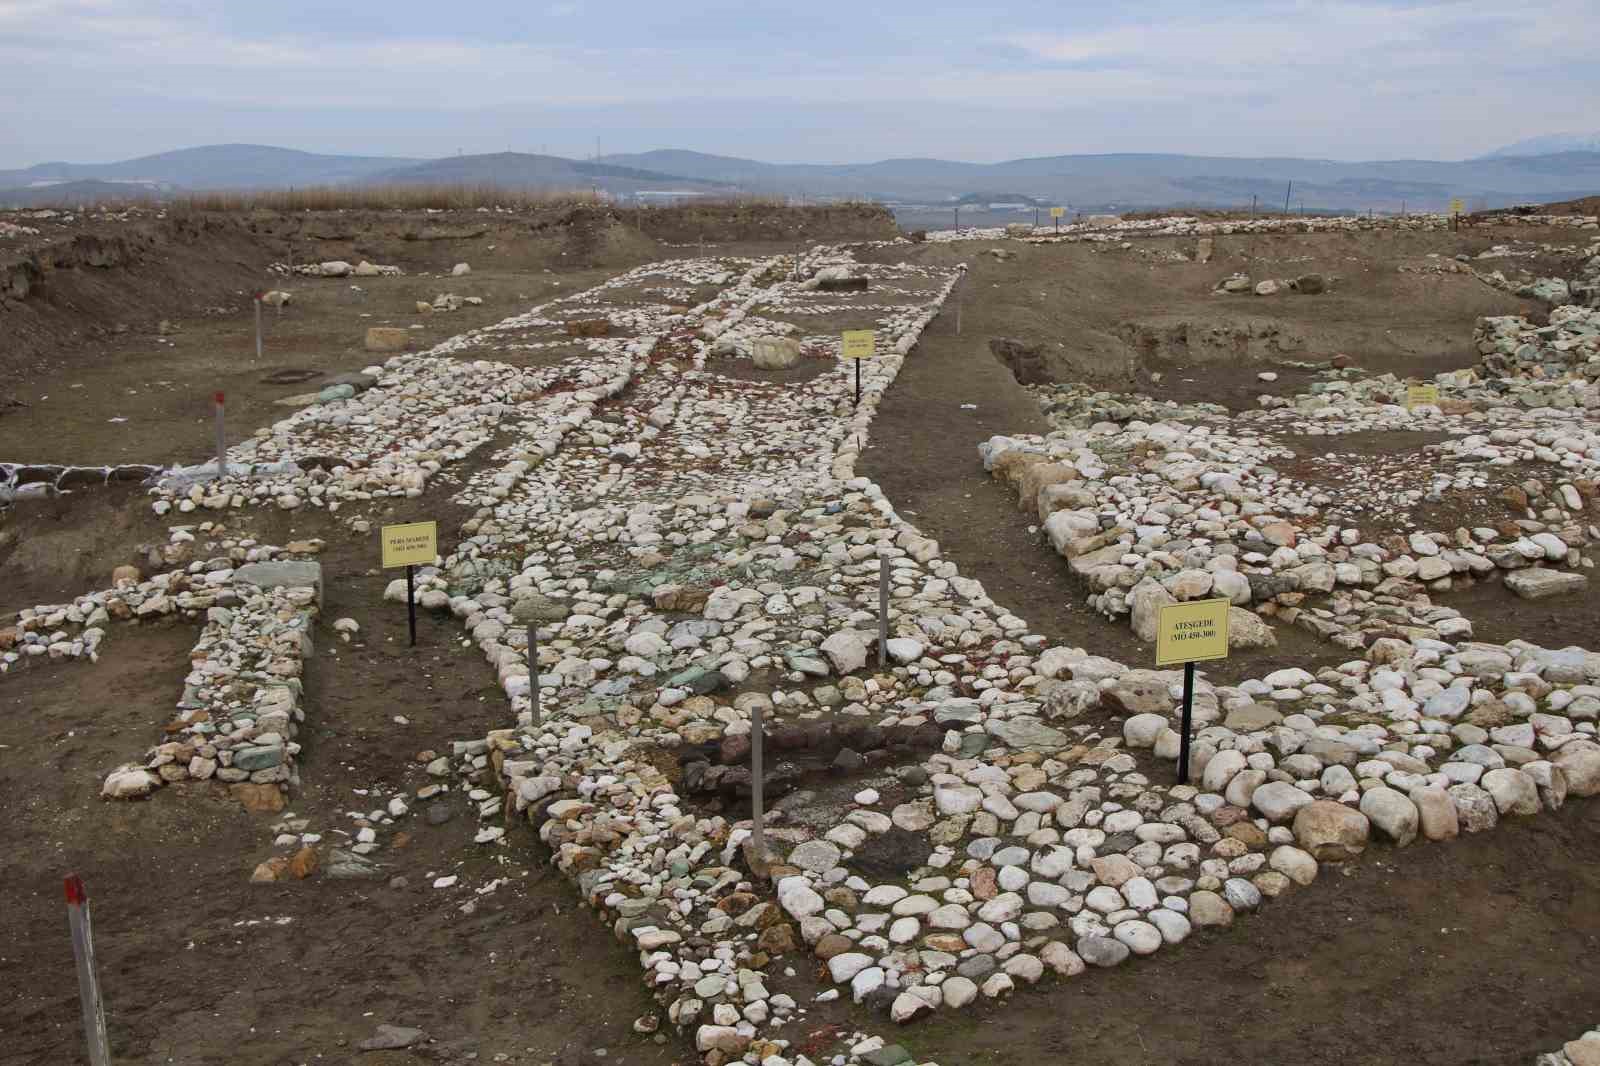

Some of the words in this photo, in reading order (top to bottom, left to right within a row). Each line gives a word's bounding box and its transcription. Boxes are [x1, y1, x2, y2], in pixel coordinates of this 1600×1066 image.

[1174, 619, 1215, 630] ATEŞGEDE
[1171, 631, 1187, 641] (MÖ
[1188, 629, 1216, 640] 450-300)
